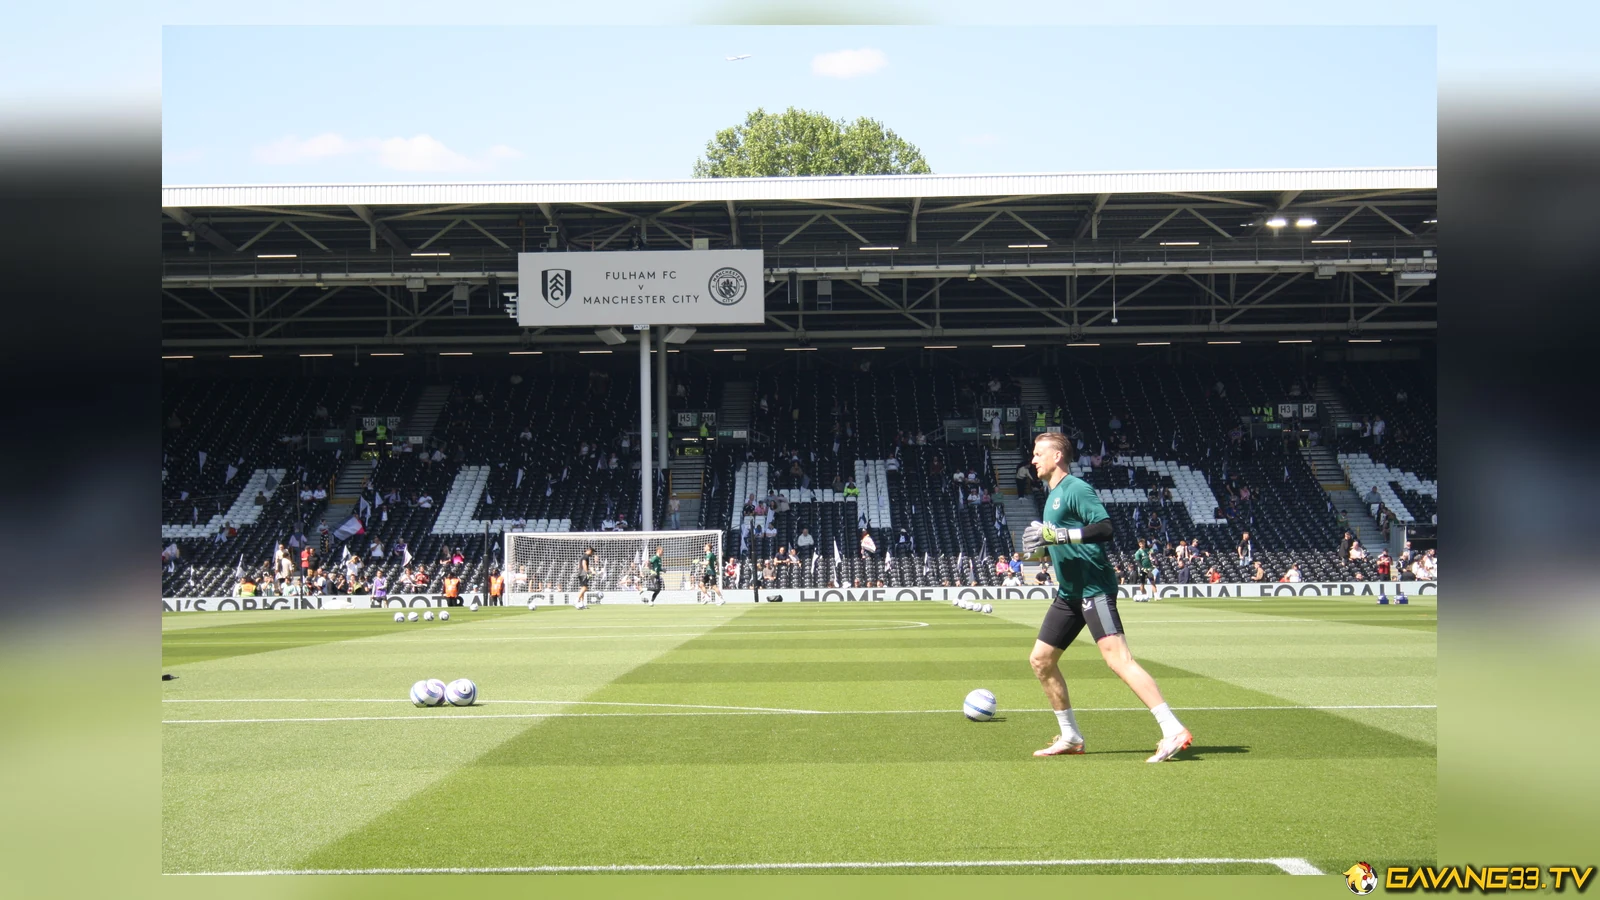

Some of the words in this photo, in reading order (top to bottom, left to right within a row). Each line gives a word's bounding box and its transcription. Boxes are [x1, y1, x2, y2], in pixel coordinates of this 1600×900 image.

[605, 271, 656, 280] FULHAM
[662, 271, 677, 280] FC
[583, 295, 666, 304] MANCHESTER
[672, 294, 700, 304] CITY
[1008, 409, 1019, 417] H3
[1280, 405, 1291, 413] H3
[1304, 404, 1315, 413] H2
[800, 589, 886, 602] HOME
[895, 588, 934, 601] OF
